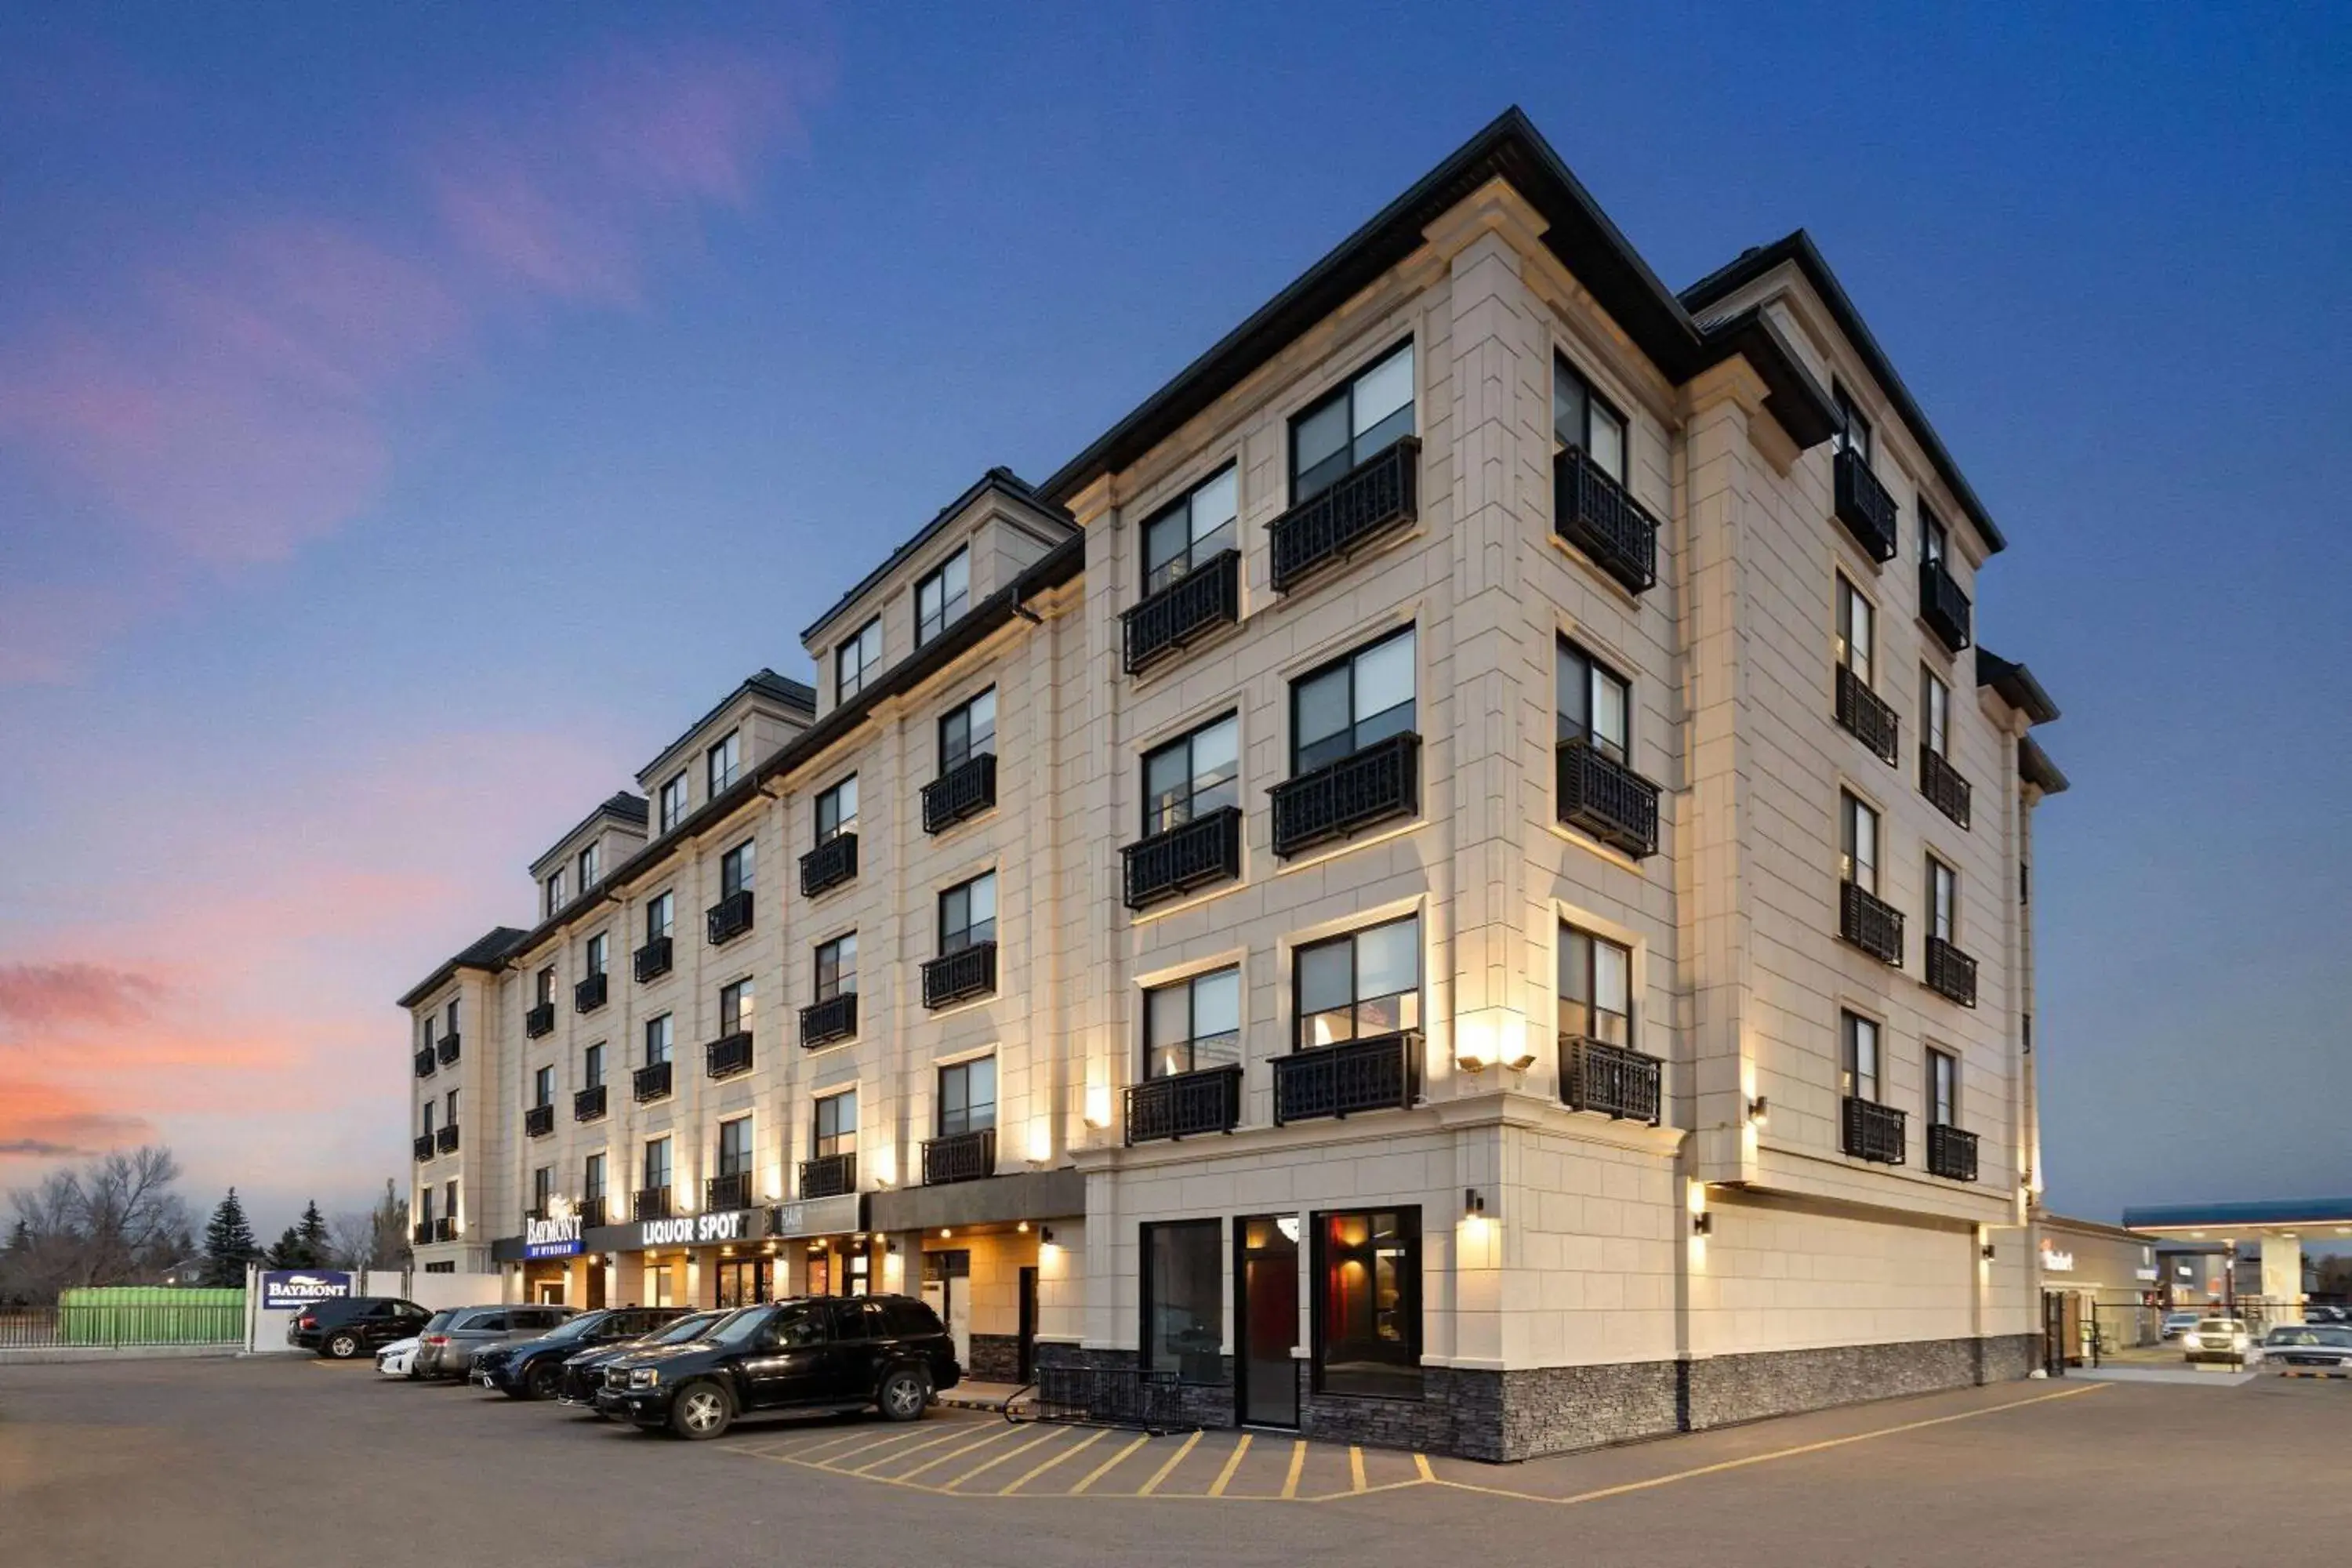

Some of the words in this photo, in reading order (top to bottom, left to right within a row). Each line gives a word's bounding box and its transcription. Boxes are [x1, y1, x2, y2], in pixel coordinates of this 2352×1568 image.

[526, 1215, 583, 1246] BAYMONT
[643, 1218, 694, 1245] LIQUOR
[699, 1211, 739, 1241] SPOT
[268, 1282, 347, 1296] BAYMONT
